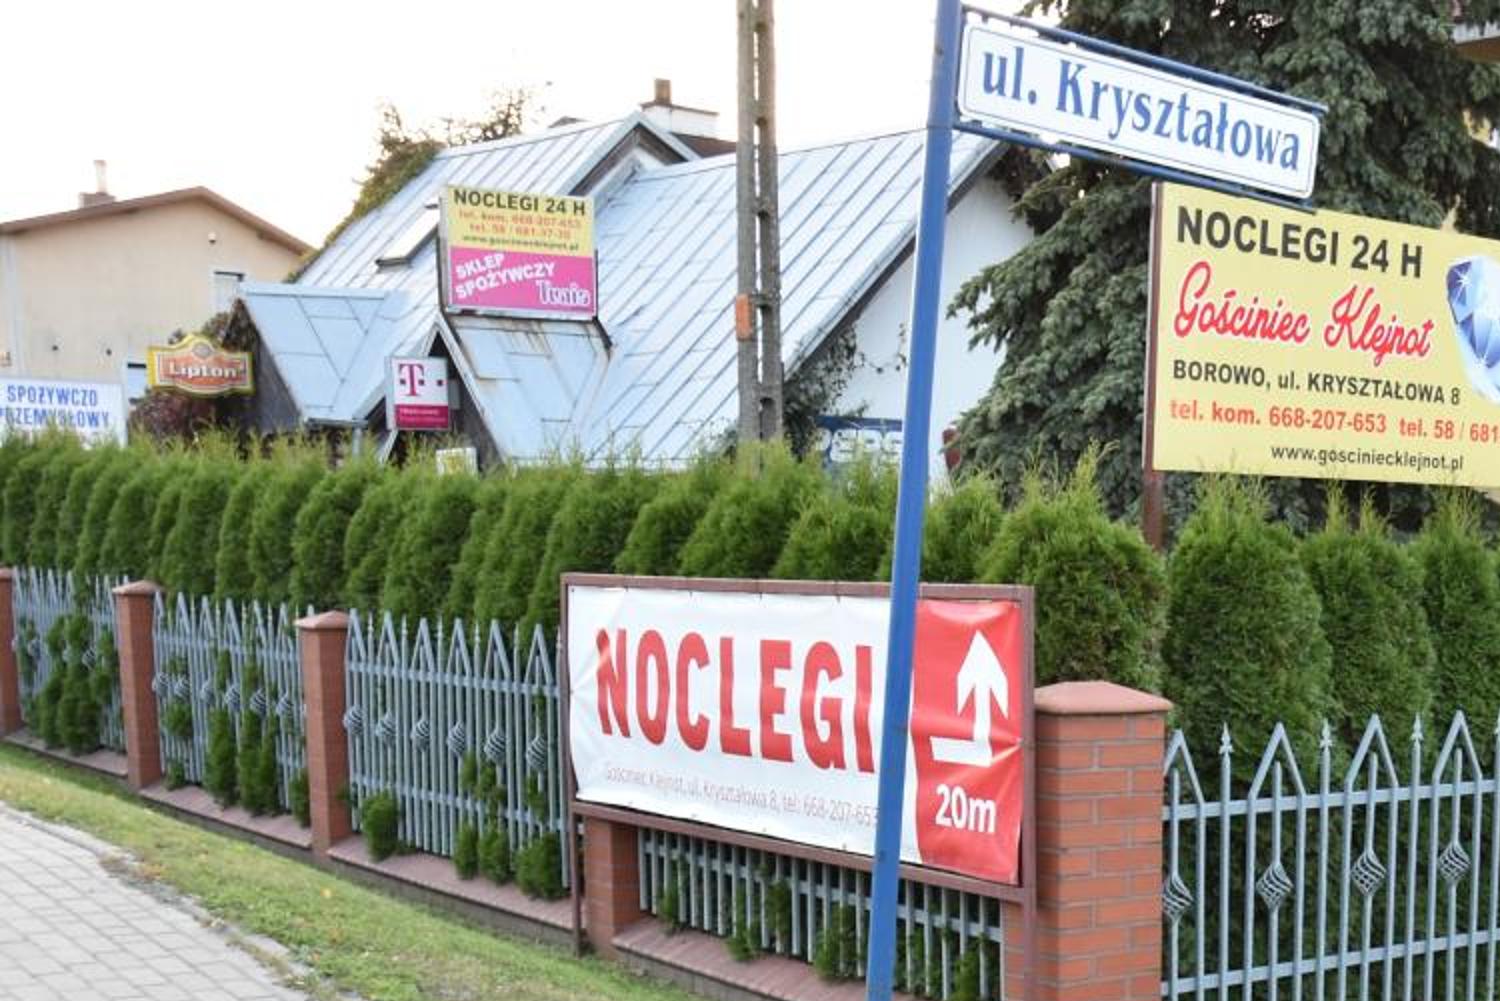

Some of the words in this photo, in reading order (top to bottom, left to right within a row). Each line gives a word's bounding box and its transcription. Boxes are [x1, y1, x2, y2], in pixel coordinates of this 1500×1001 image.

[983, 47, 1037, 105] ul.
[1056, 59, 1299, 171] Kryształowa
[454, 189, 538, 211] NOCLEGI
[546, 200, 566, 214] 24
[573, 201, 585, 216] H
[1178, 206, 1339, 266] NOCLEGI
[1351, 235, 1389, 273] 24
[1401, 243, 1422, 278] H
[455, 262, 555, 299] SPOŻYWCZY
[456, 253, 504, 278] SKLEP
[1174, 261, 1310, 343] Gościniec
[1324, 285, 1434, 367] Klejnot
[169, 361, 237, 379] Lipton
[1173, 359, 1271, 391] BOROWO,
[1278, 370, 1301, 391] ul.
[1307, 372, 1446, 405] KRYSZTAŁOWA
[1450, 387, 1461, 406] 8
[1171, 400, 1204, 421] tel.
[1211, 401, 1261, 425] kom.
[1268, 405, 1387, 434] 668-207-653
[1399, 416, 1428, 438] tel.
[1434, 419, 1455, 440] 58
[1270, 445, 1464, 473] www.gosciniecklejnot.pl
[595, 628, 876, 774] NOCLEGI
[935, 783, 997, 834] 20m
